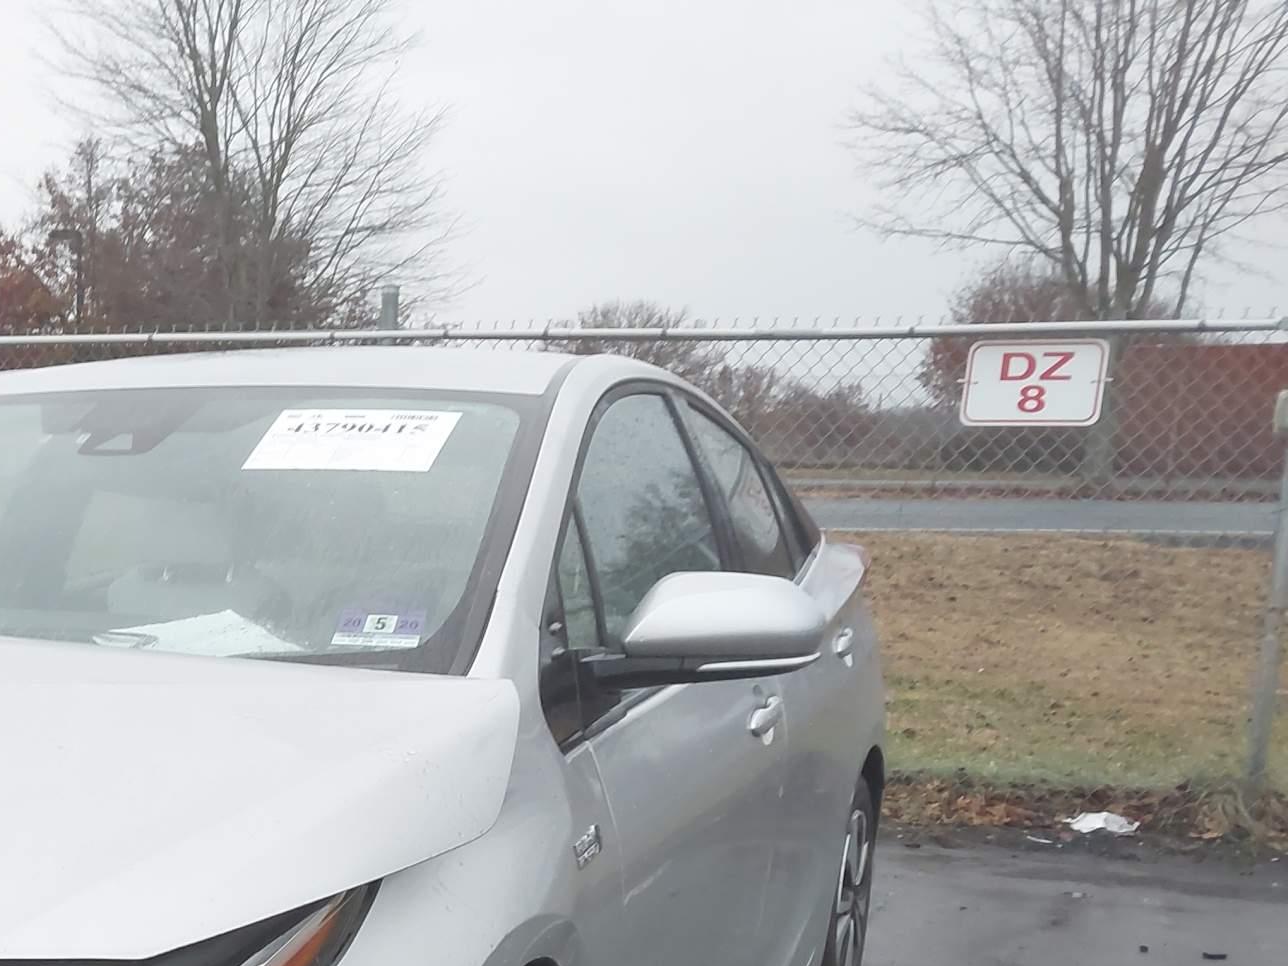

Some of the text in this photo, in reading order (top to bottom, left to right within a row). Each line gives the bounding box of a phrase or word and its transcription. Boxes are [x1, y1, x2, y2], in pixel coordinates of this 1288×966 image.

[999, 351, 1076, 381] DZ
[1017, 384, 1046, 413] 8
[374, 616, 389, 630] 5
